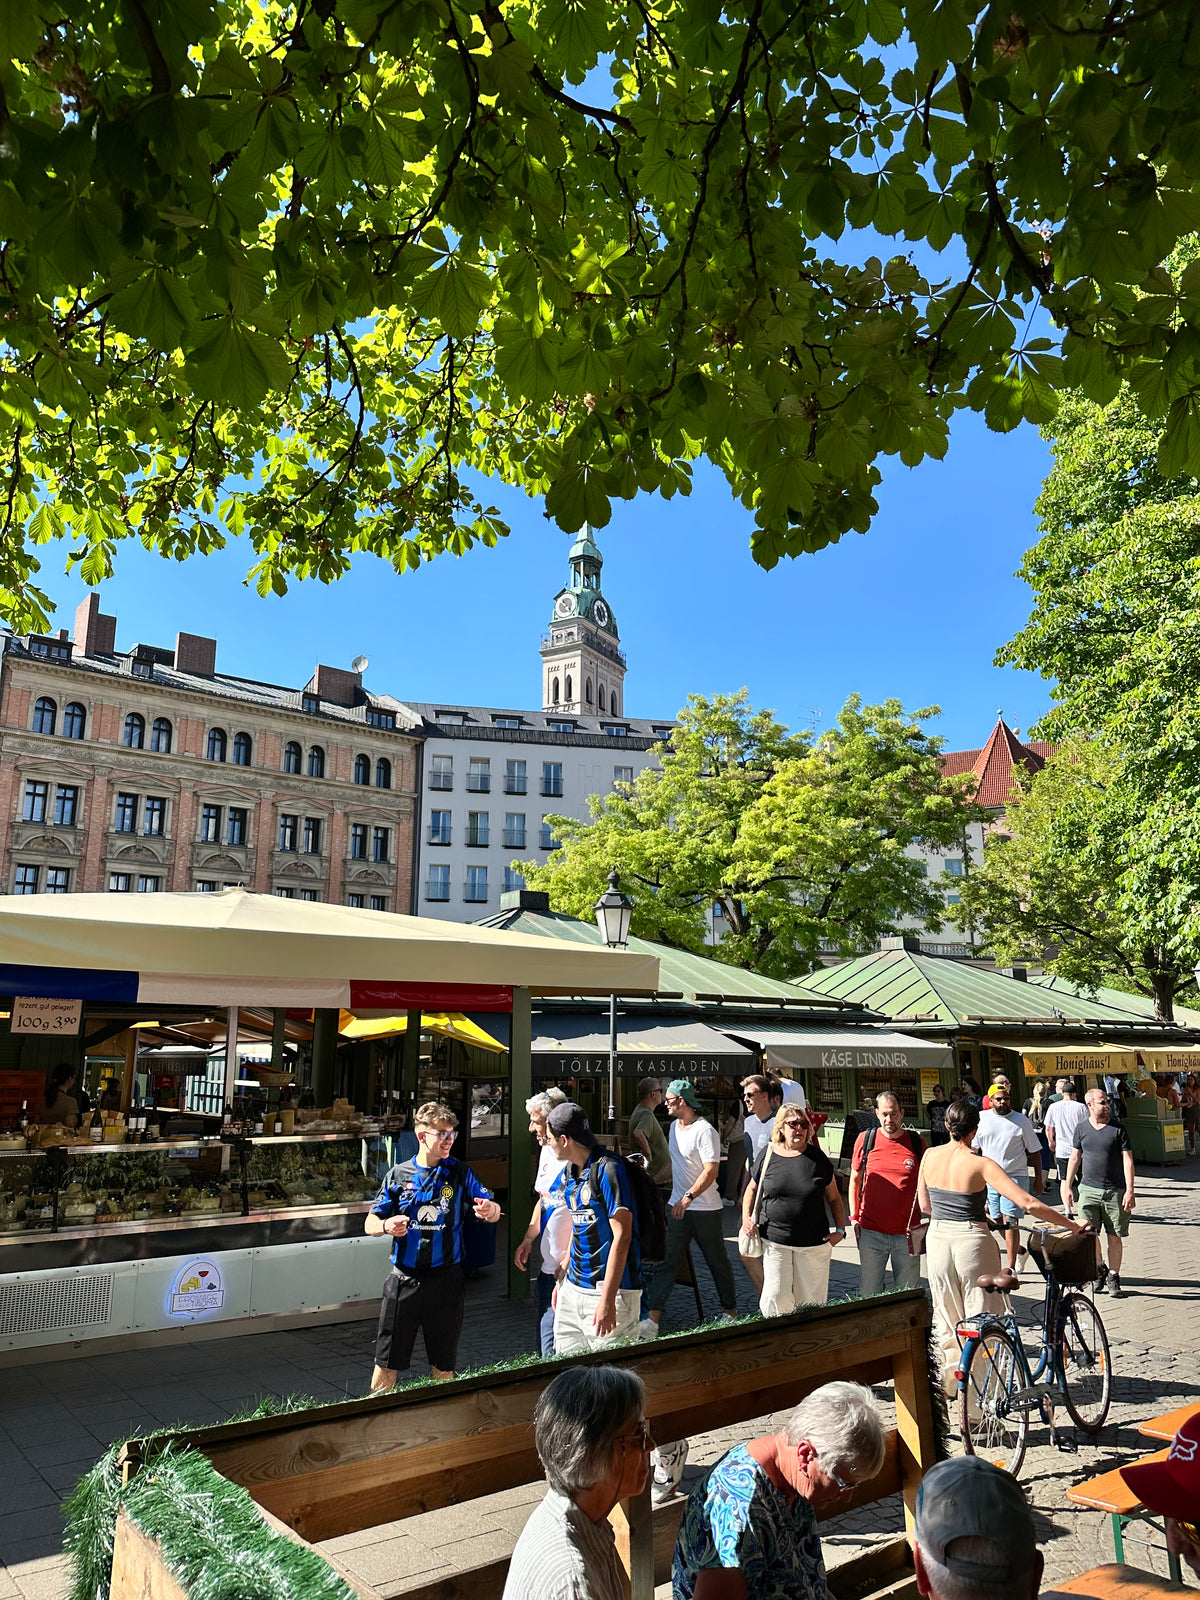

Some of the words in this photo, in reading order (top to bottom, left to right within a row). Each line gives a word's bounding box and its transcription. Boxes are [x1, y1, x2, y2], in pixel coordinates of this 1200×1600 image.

[821, 1049, 853, 1067] KÄSE
[856, 1052, 909, 1067] LINDNER
[637, 1060, 720, 1072] KASLADEN
